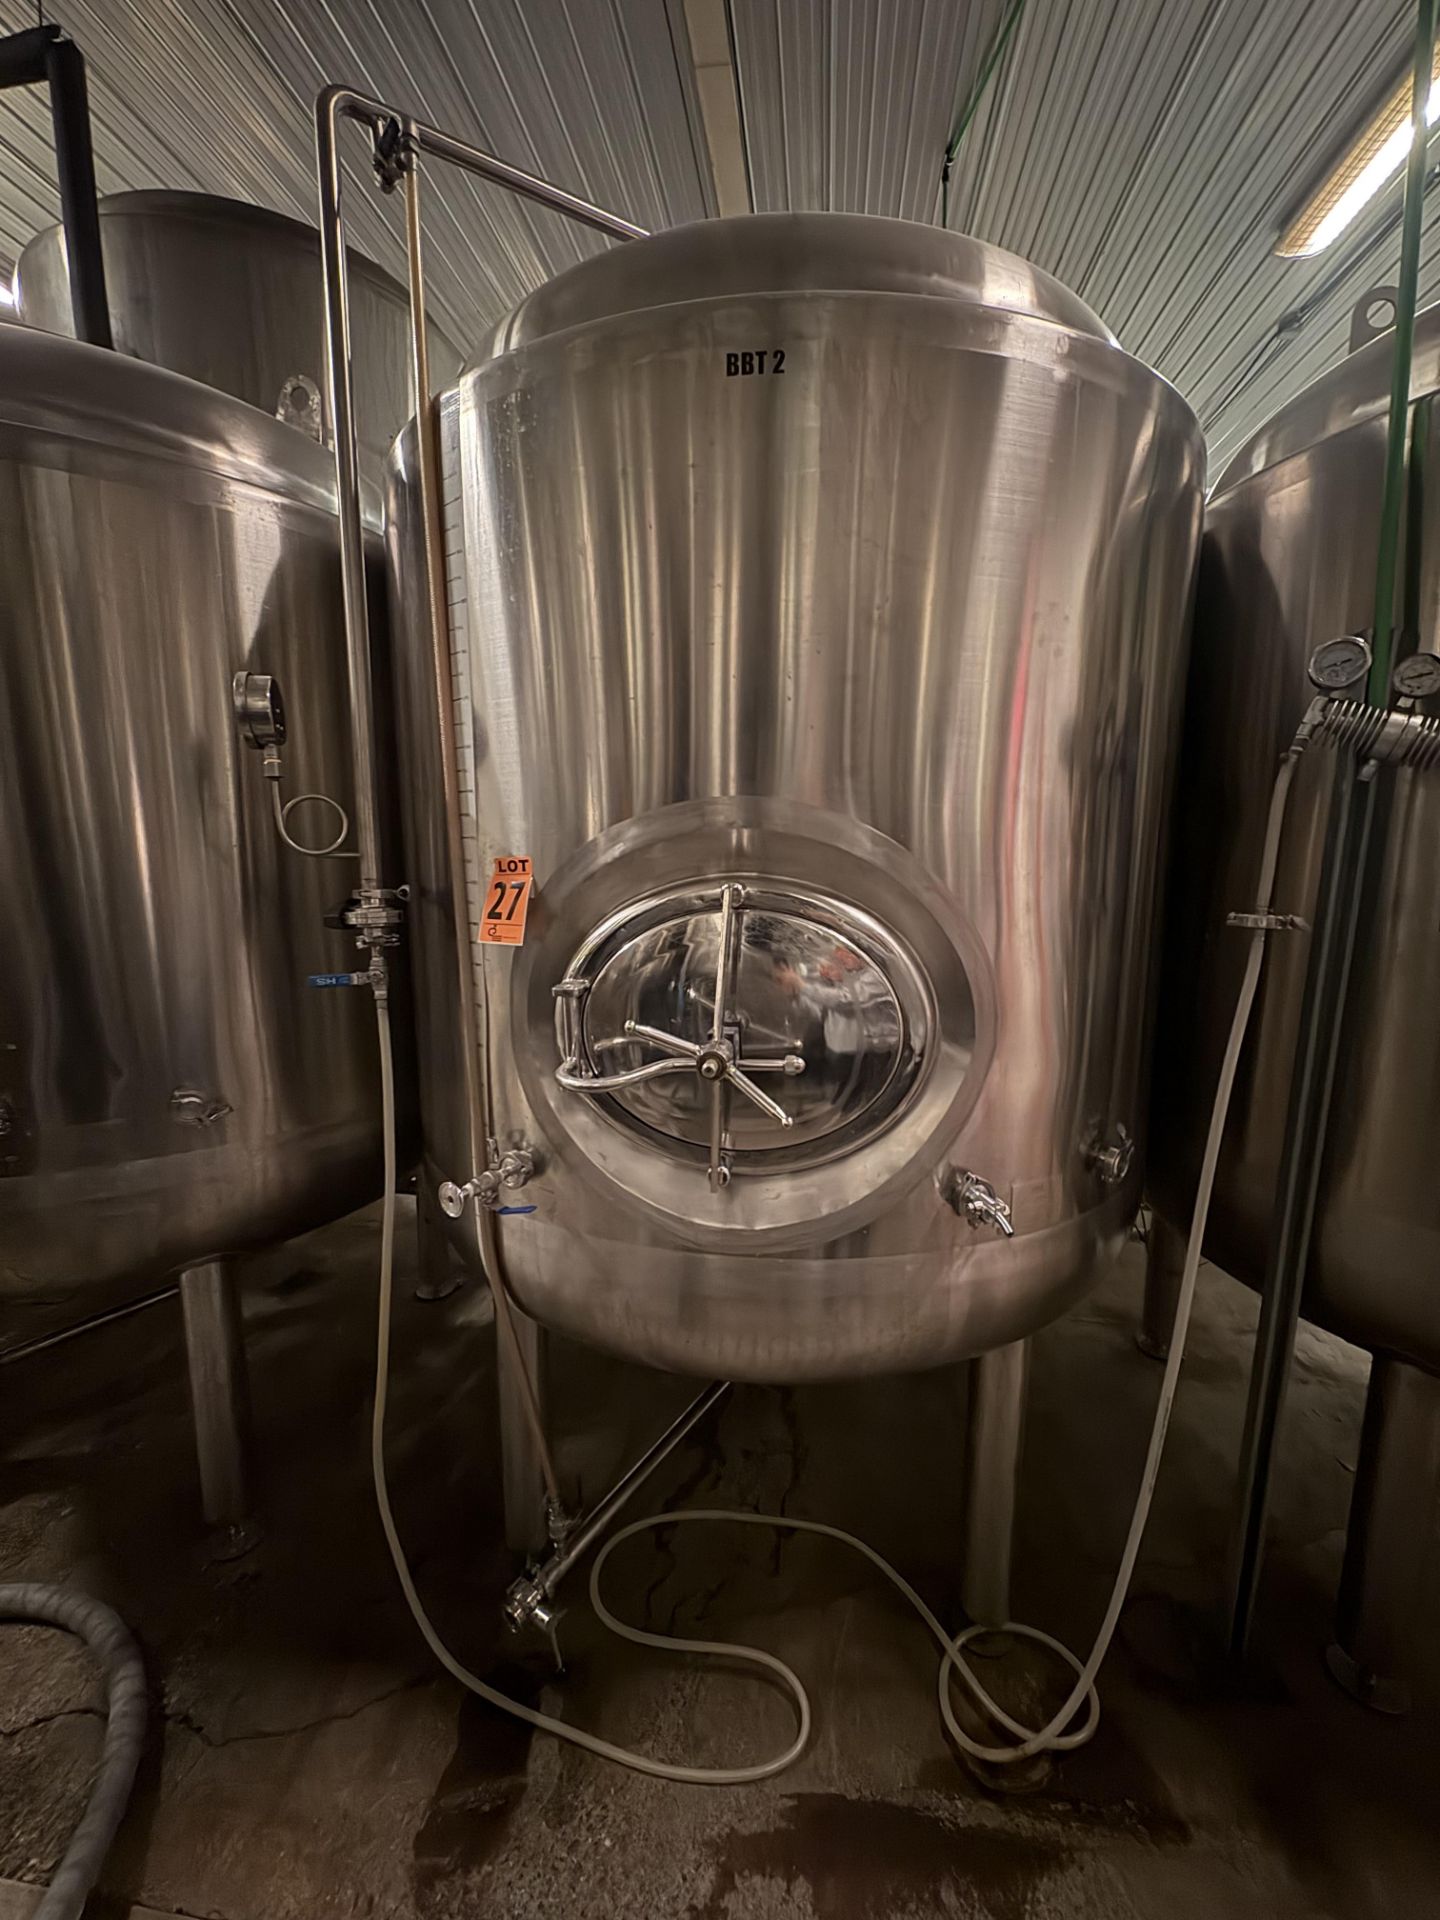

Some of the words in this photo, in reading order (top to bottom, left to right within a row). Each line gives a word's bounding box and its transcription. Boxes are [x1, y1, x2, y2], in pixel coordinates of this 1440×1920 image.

[727, 350, 767, 377] BBT
[772, 349, 785, 374] 2
[498, 859, 528, 872] LOT
[487, 881, 525, 920] 27
